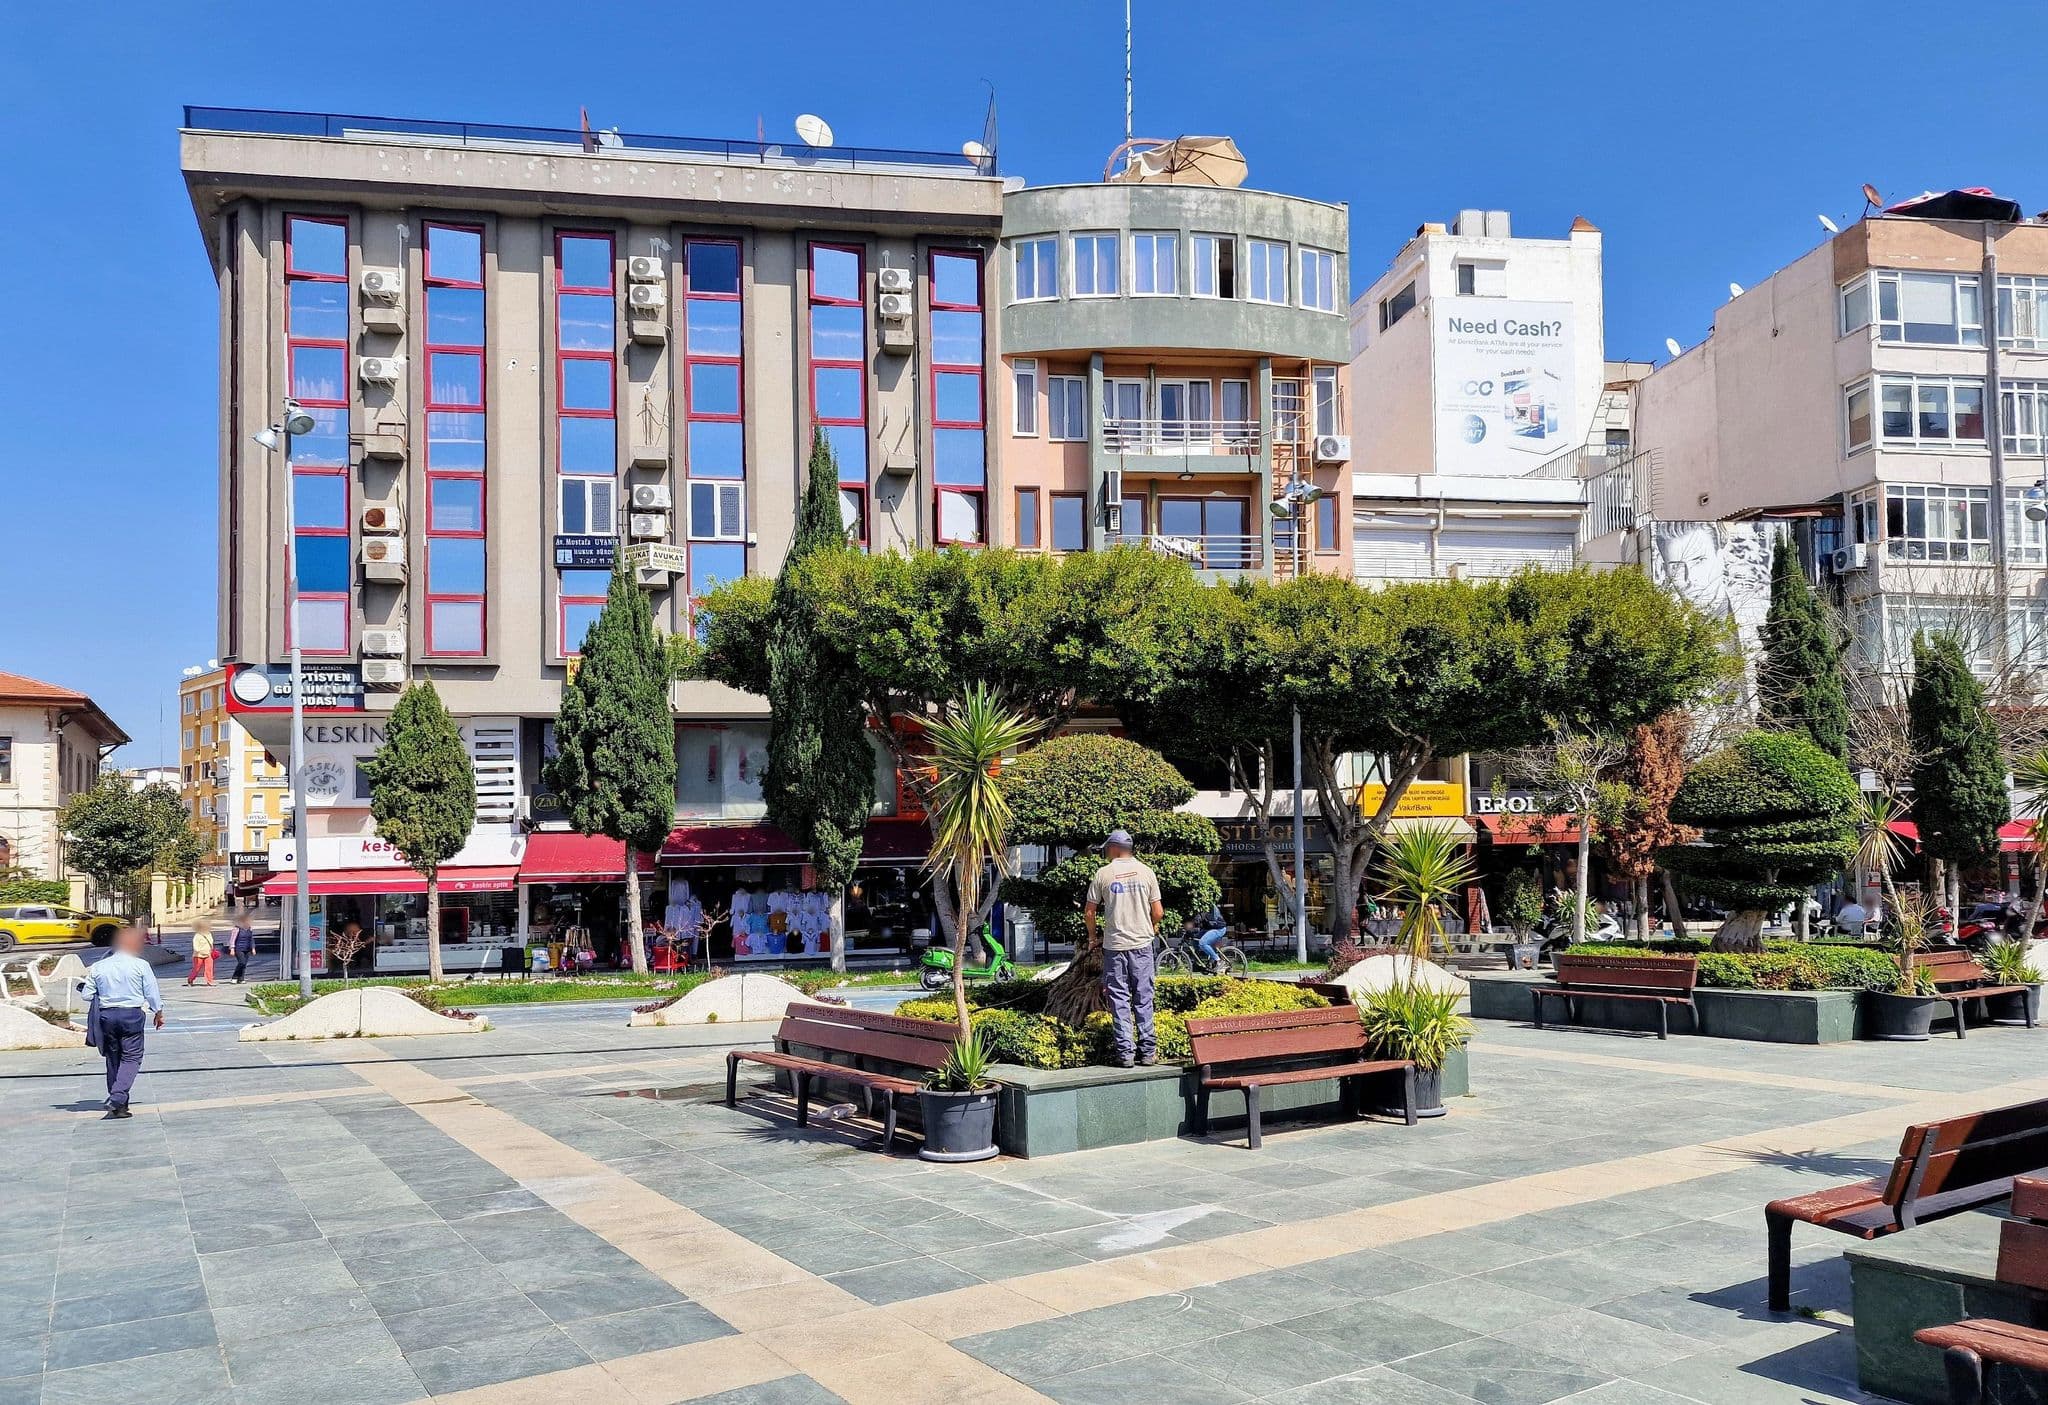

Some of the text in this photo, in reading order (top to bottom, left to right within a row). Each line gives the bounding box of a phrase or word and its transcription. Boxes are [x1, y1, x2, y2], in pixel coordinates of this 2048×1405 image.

[1448, 317, 1562, 336] Need Cash?
[653, 551, 684, 561] AVUKAT
[289, 670, 351, 682] PTİSYEN
[1477, 796, 1539, 812] EROL
[1220, 824, 1316, 841] ST LGHT
[1226, 843, 1256, 851] SHOES
